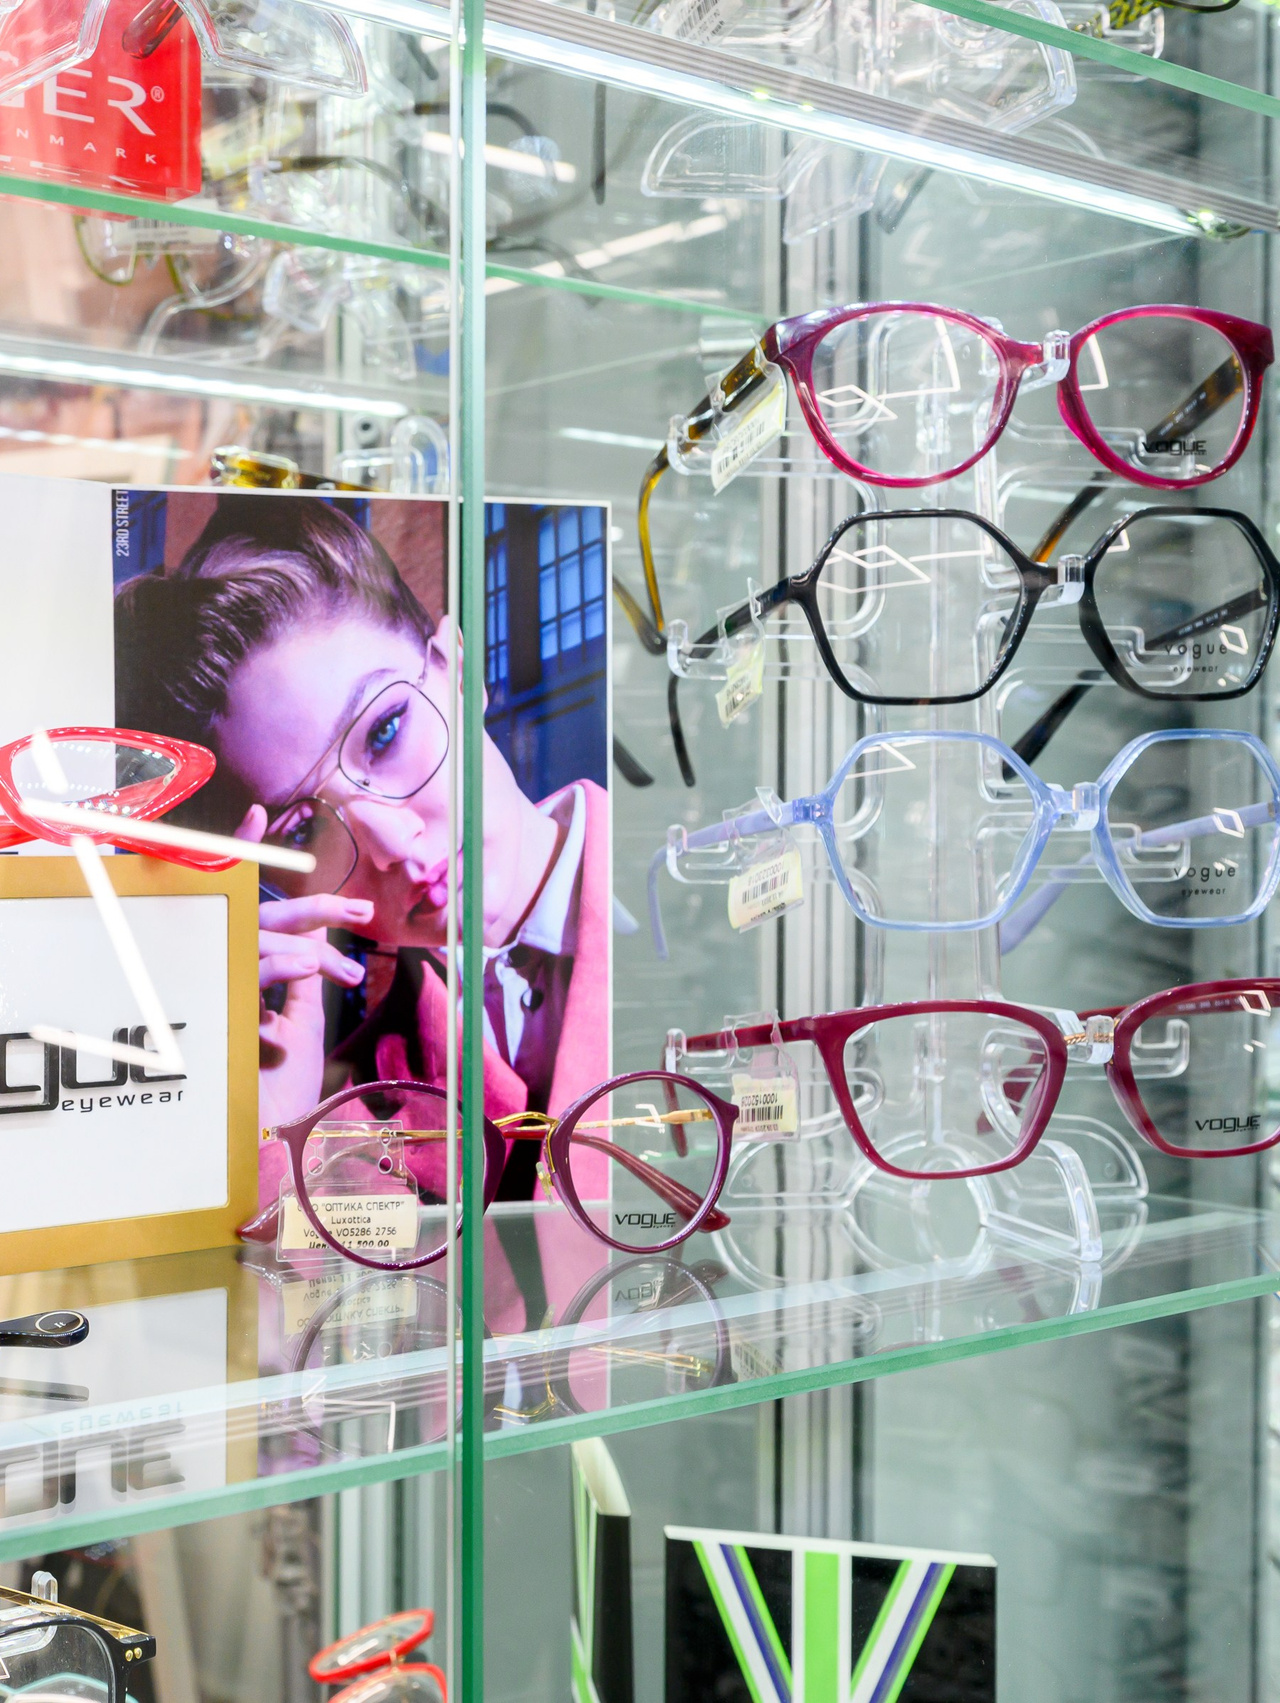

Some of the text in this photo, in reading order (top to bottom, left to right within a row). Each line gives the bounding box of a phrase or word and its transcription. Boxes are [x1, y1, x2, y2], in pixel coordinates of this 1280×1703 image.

[115, 489, 130, 557] 23RD STREET
[61, 1089, 185, 1114] eyewear
[331, 1216, 372, 1225] Luxottica
[336, 1227, 372, 1237] VO5286
[375, 1226, 397, 1236] 2756
